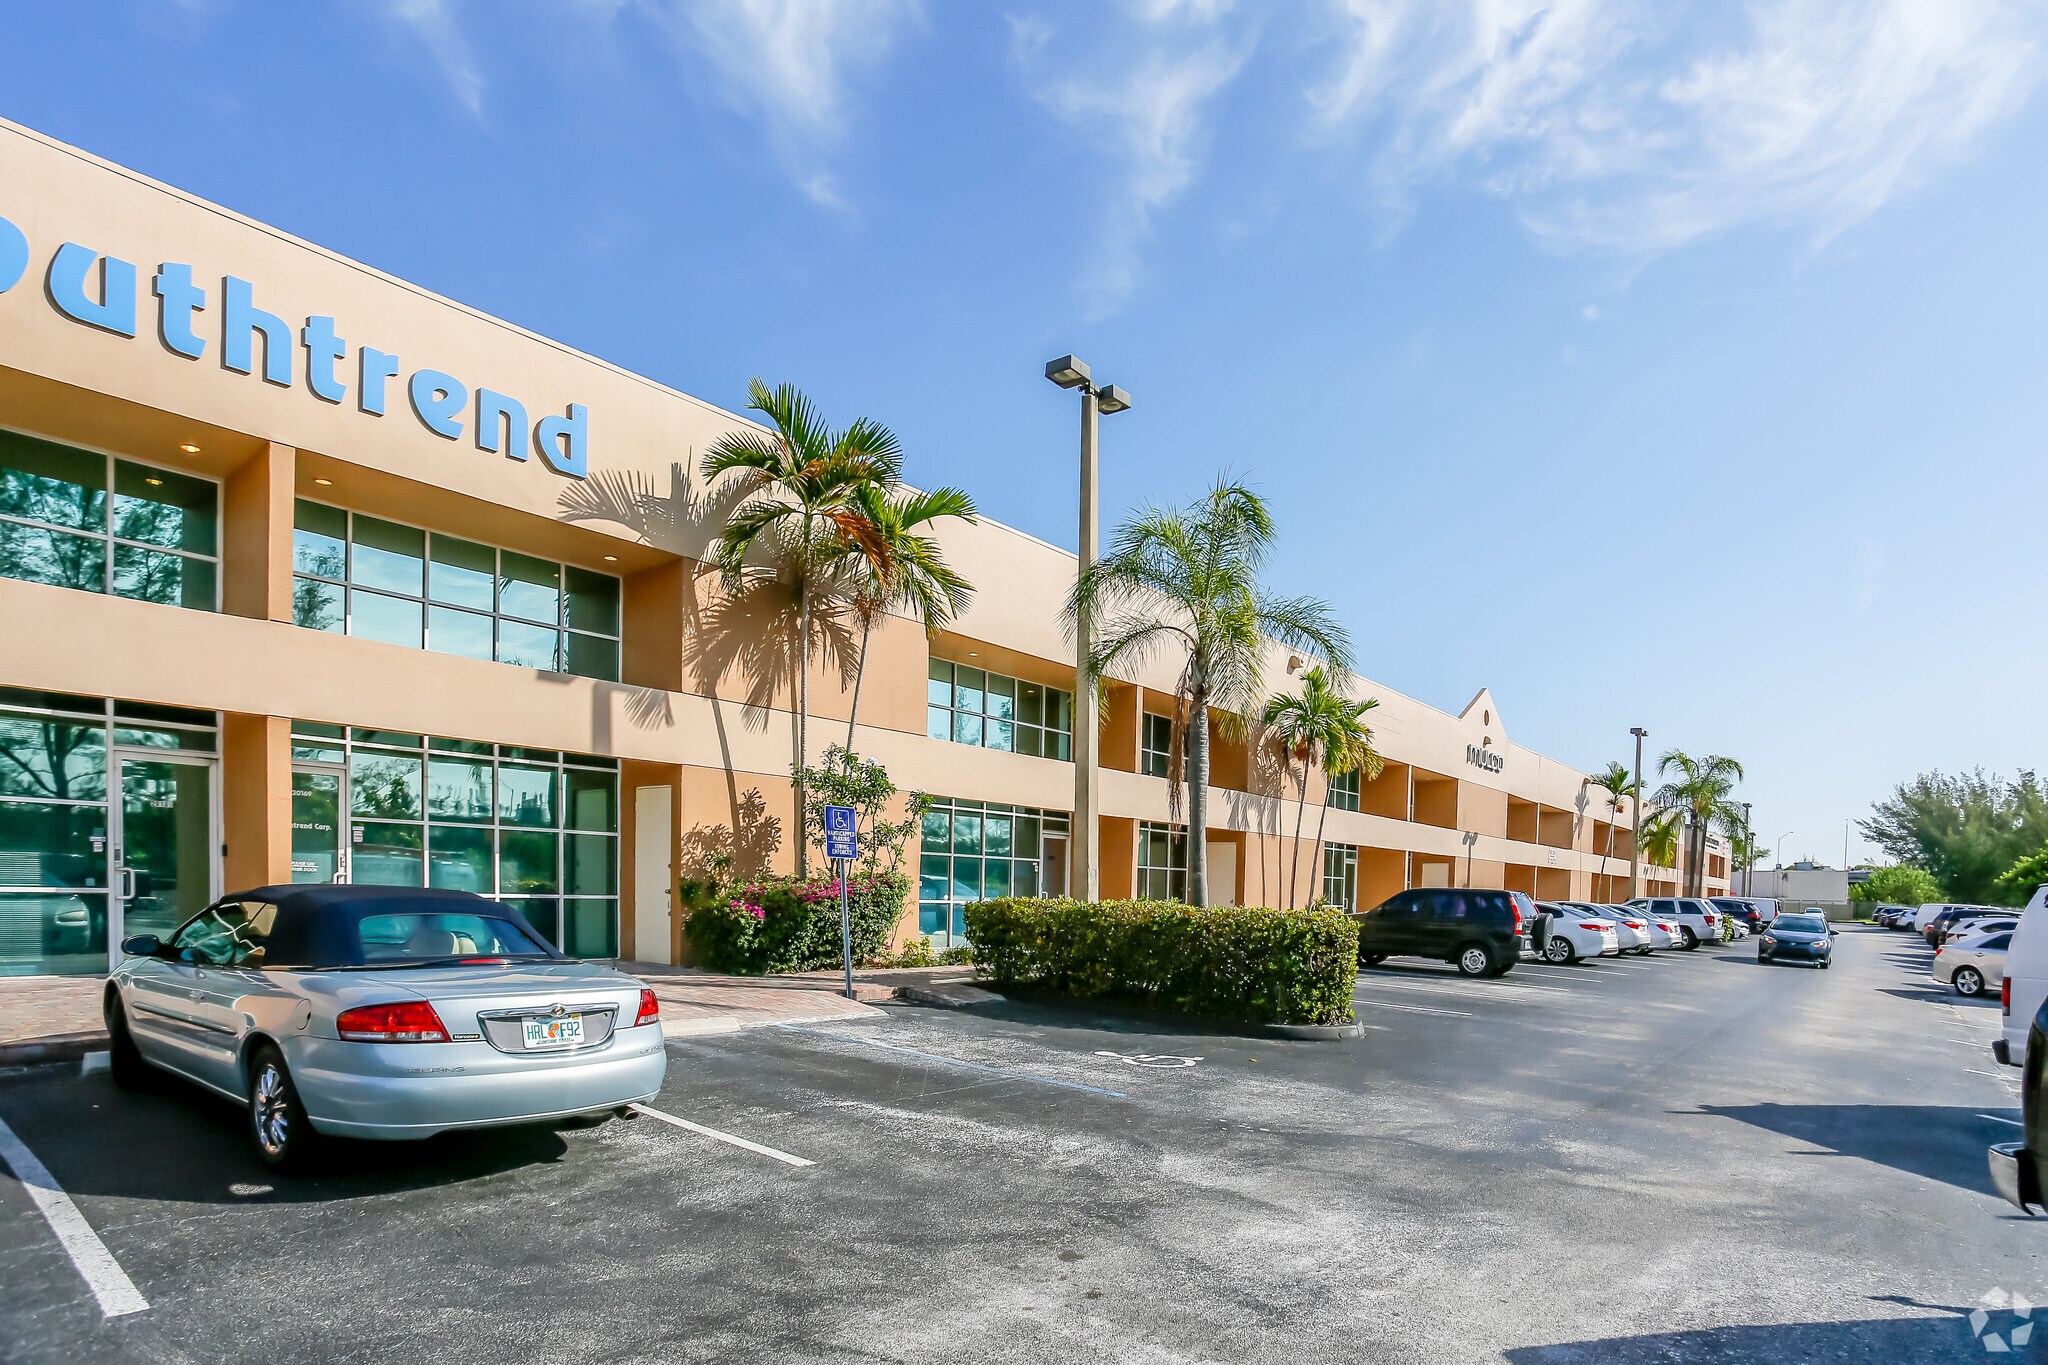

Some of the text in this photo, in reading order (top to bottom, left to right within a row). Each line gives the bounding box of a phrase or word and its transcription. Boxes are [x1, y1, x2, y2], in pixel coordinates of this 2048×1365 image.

[314, 823, 332, 832] Corp.
[526, 1021, 581, 1040] HRL F92
